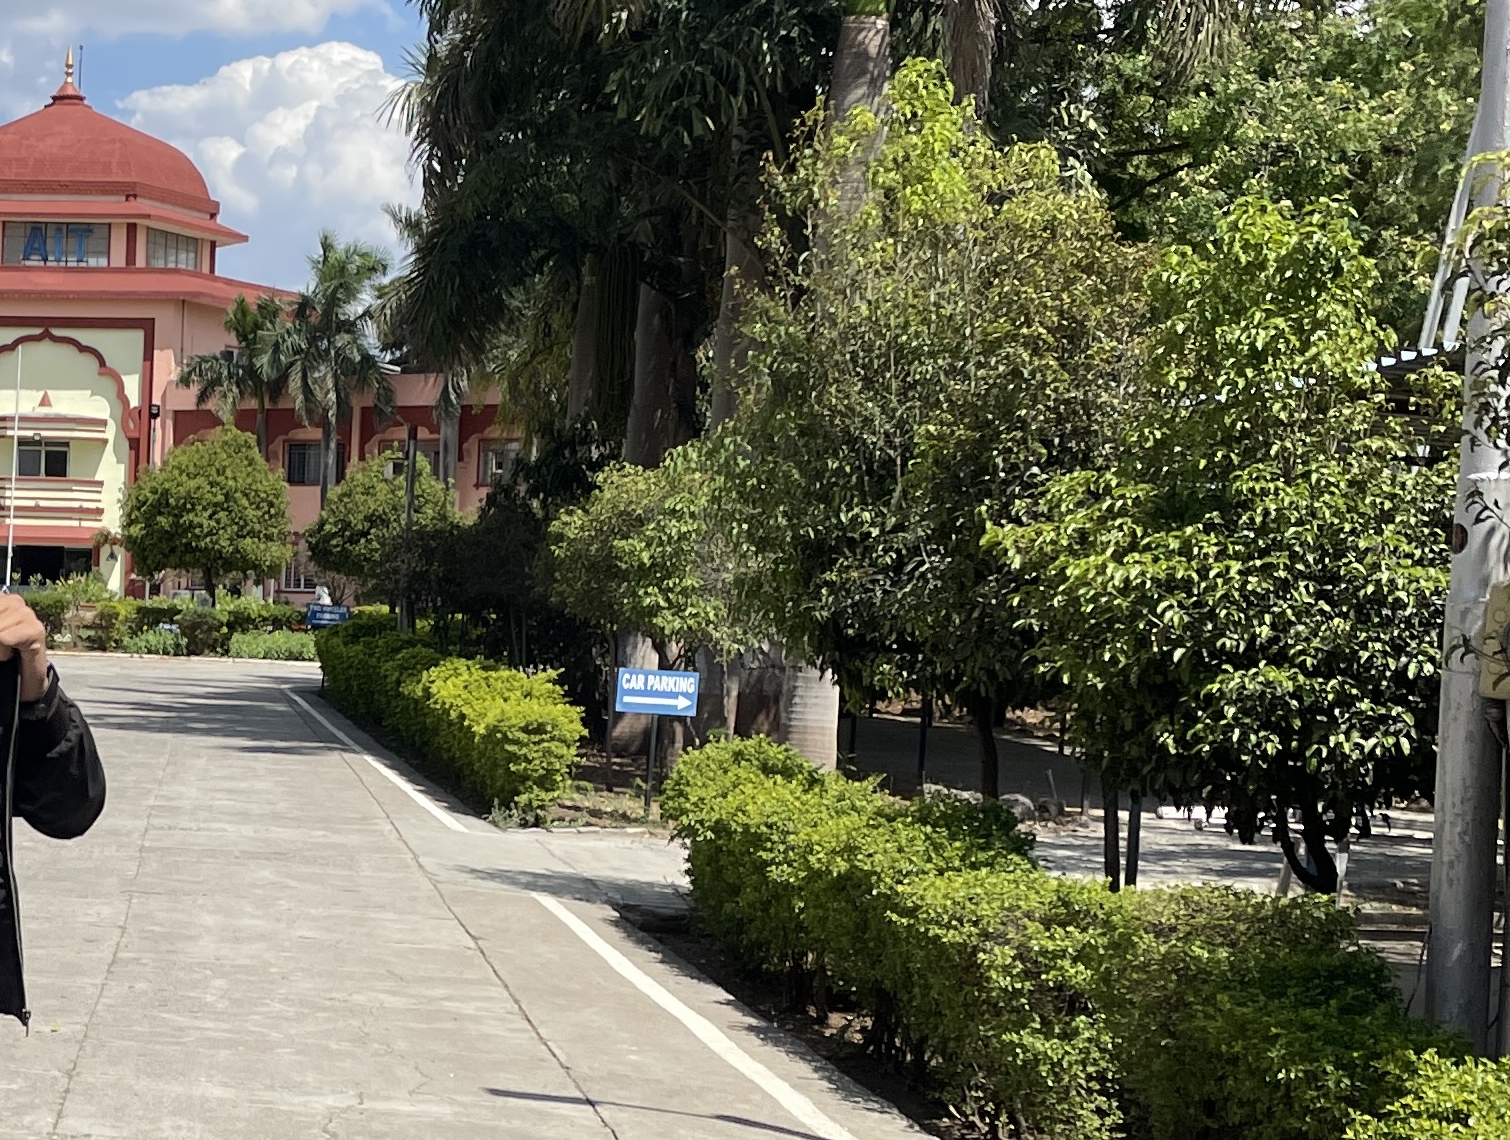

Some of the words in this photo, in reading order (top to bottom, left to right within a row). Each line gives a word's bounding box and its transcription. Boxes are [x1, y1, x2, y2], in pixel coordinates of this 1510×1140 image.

[21, 226, 93, 262] AIT
[622, 673, 644, 691] CAR
[647, 675, 695, 693] PARKING
